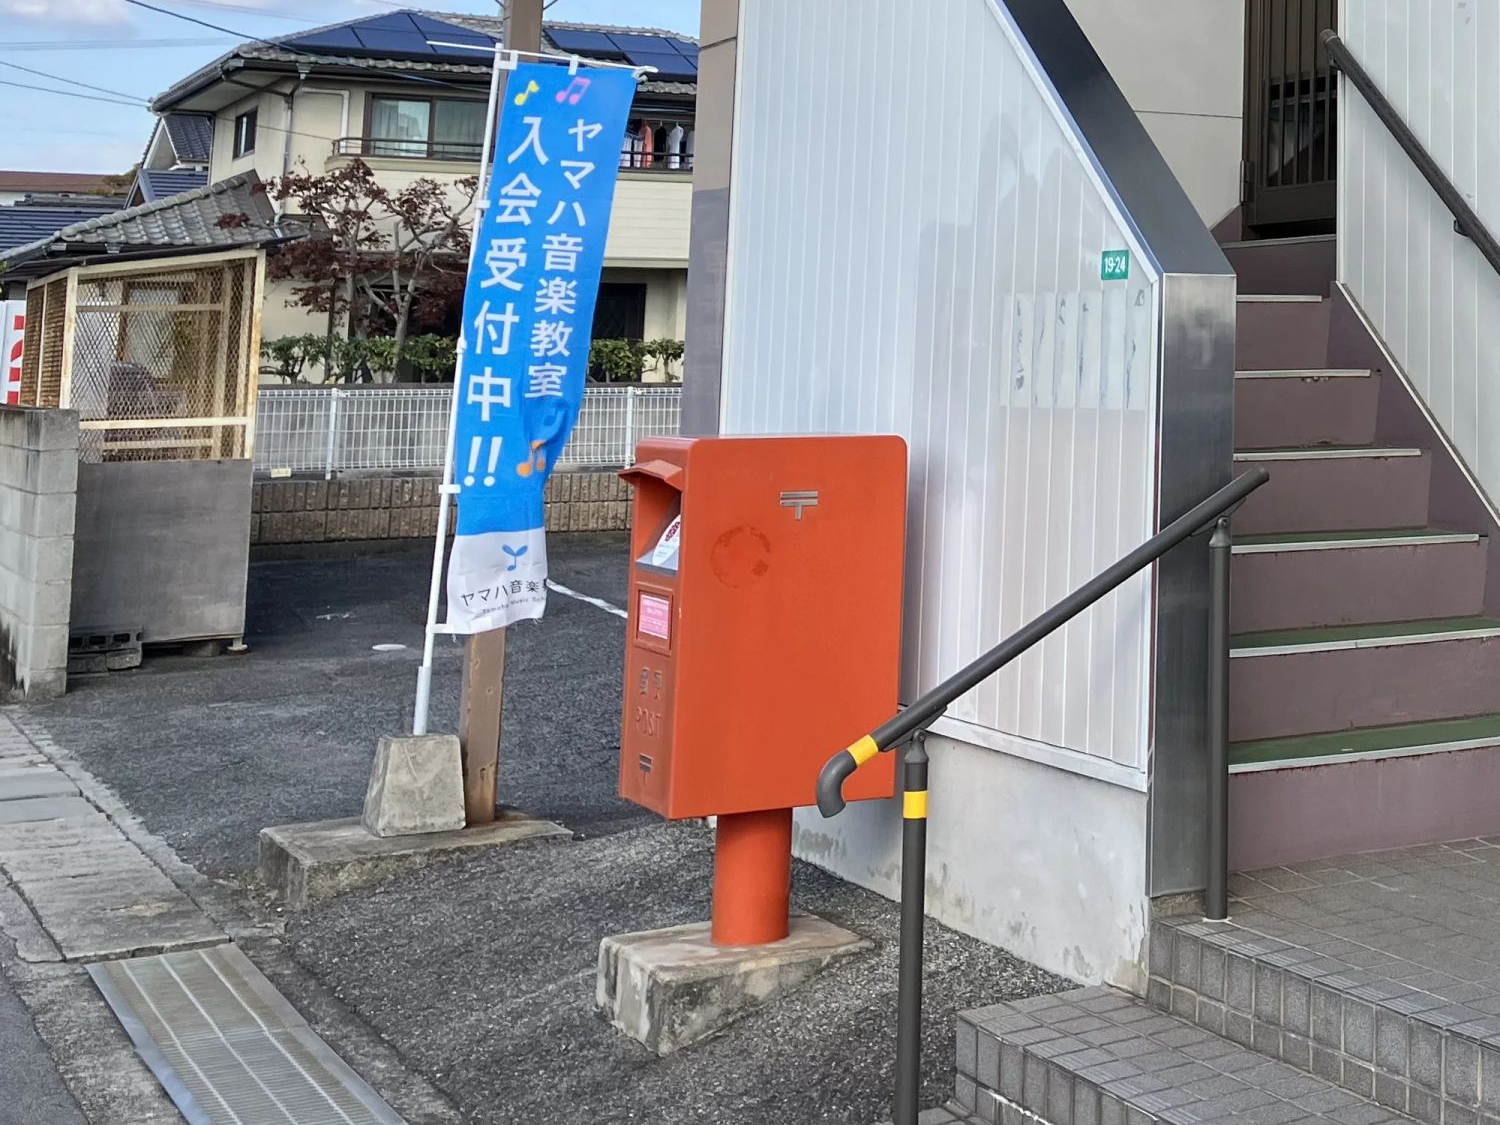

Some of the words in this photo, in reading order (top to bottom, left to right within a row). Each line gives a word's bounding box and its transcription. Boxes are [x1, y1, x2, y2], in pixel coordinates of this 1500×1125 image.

[525, 118, 602, 398] ヤマハ音楽教室
[1104, 255, 1126, 274] 19-24
[464, 116, 549, 487] 入会受付中!!
[460, 578, 547, 607] ヤマハ音楽
[634, 706, 662, 739] POST
